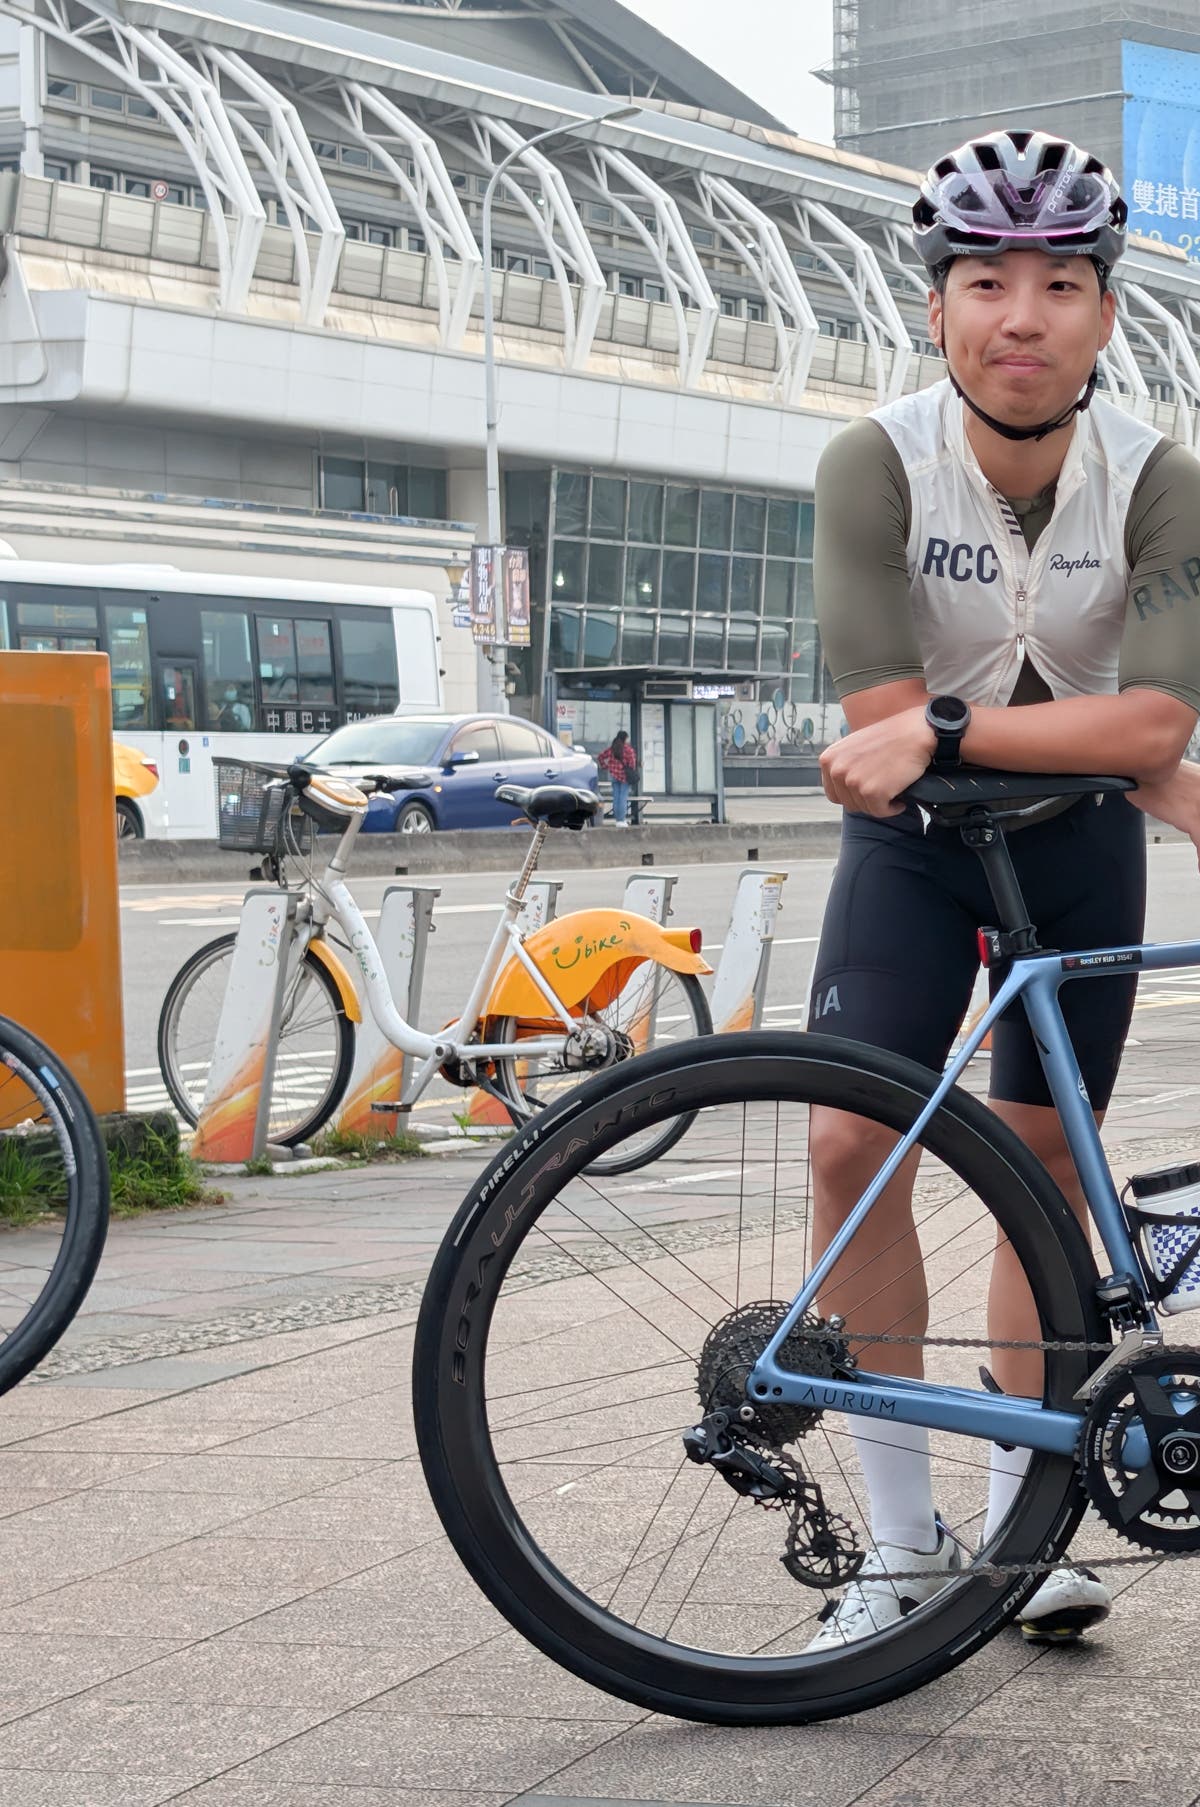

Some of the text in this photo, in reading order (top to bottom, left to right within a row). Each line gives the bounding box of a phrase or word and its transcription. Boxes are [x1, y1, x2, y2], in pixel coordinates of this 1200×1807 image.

[922, 537, 999, 584] RCC
[1050, 551, 1102, 578] Rapha
[267, 710, 332, 733] 中興巴士
[479, 1129, 540, 1202] PIRELLI
[451, 1252, 495, 1386] BORA
[491, 1136, 589, 1248] ULTRA
[802, 1386, 896, 1415] AURUM
[1094, 1427, 1103, 1460] ROTOR
